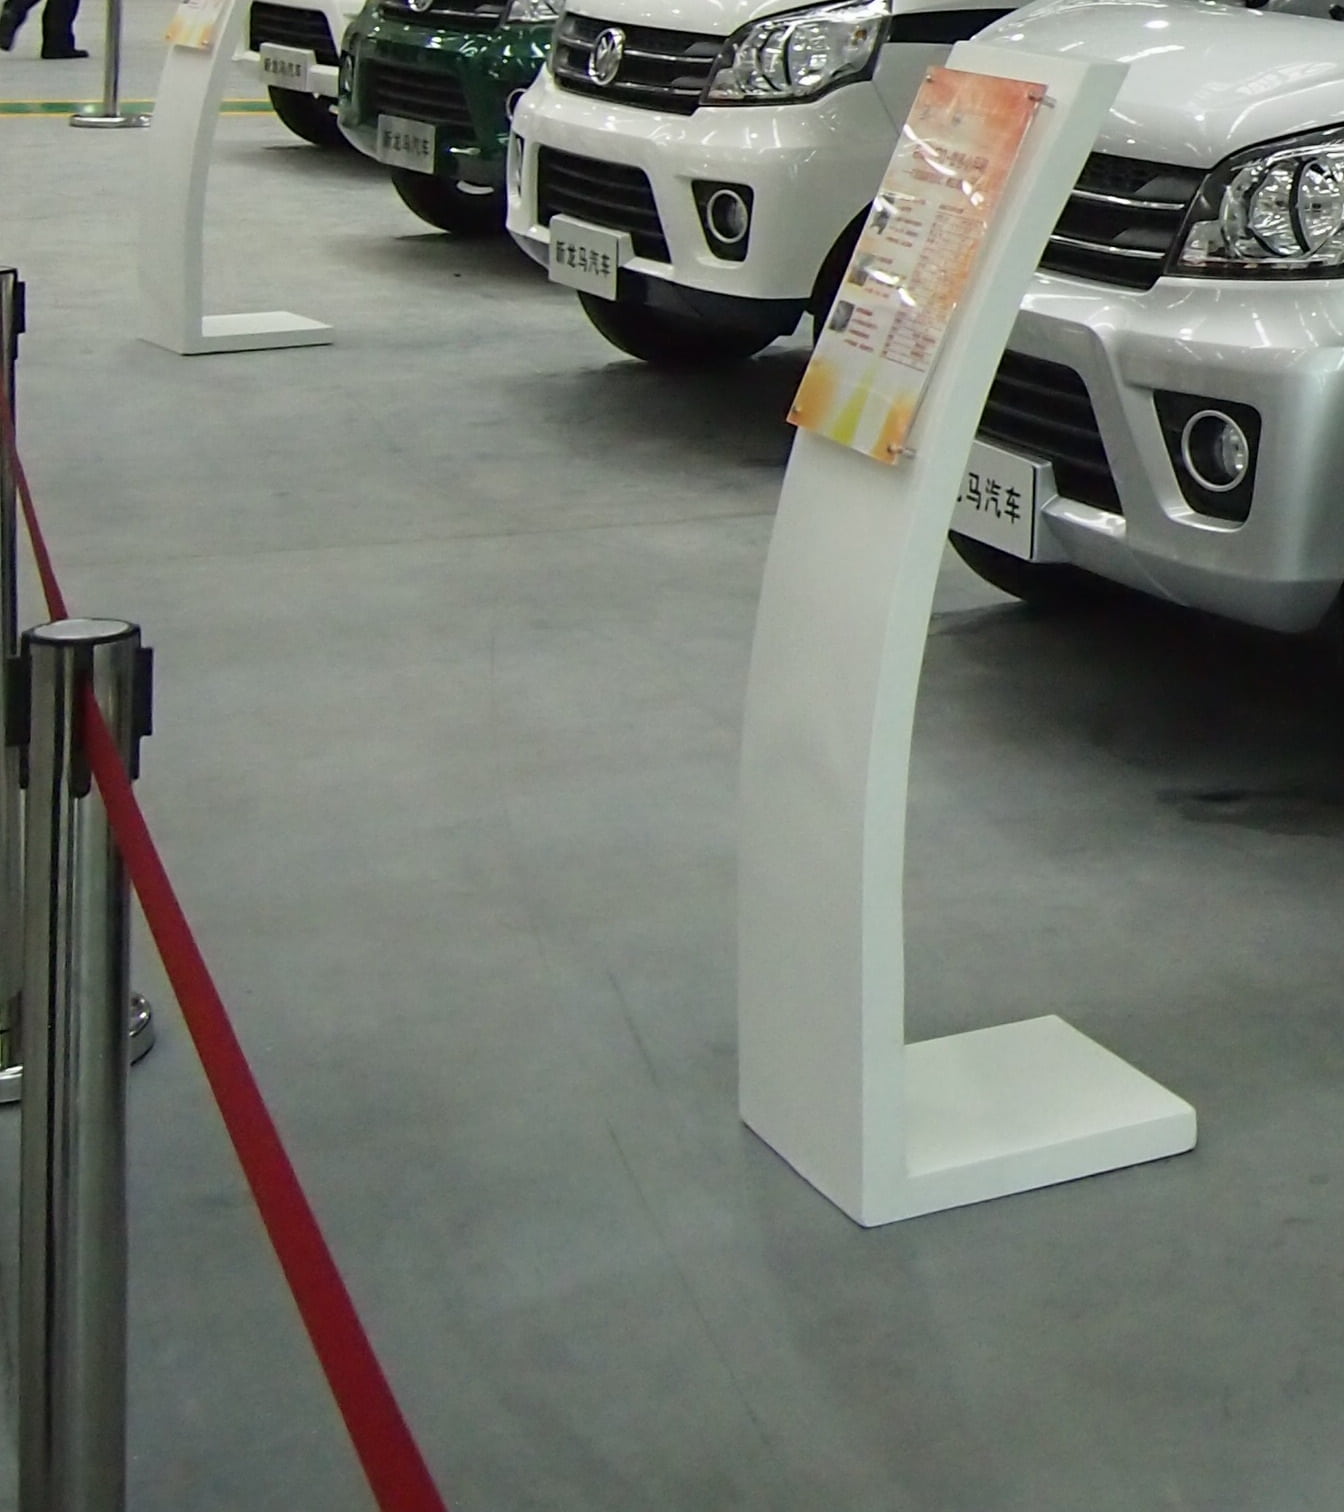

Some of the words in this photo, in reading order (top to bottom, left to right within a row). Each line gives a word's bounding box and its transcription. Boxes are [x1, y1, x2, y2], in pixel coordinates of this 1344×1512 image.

[556, 240, 610, 278] 新龙马汽车
[957, 472, 1020, 524] 马汽车
